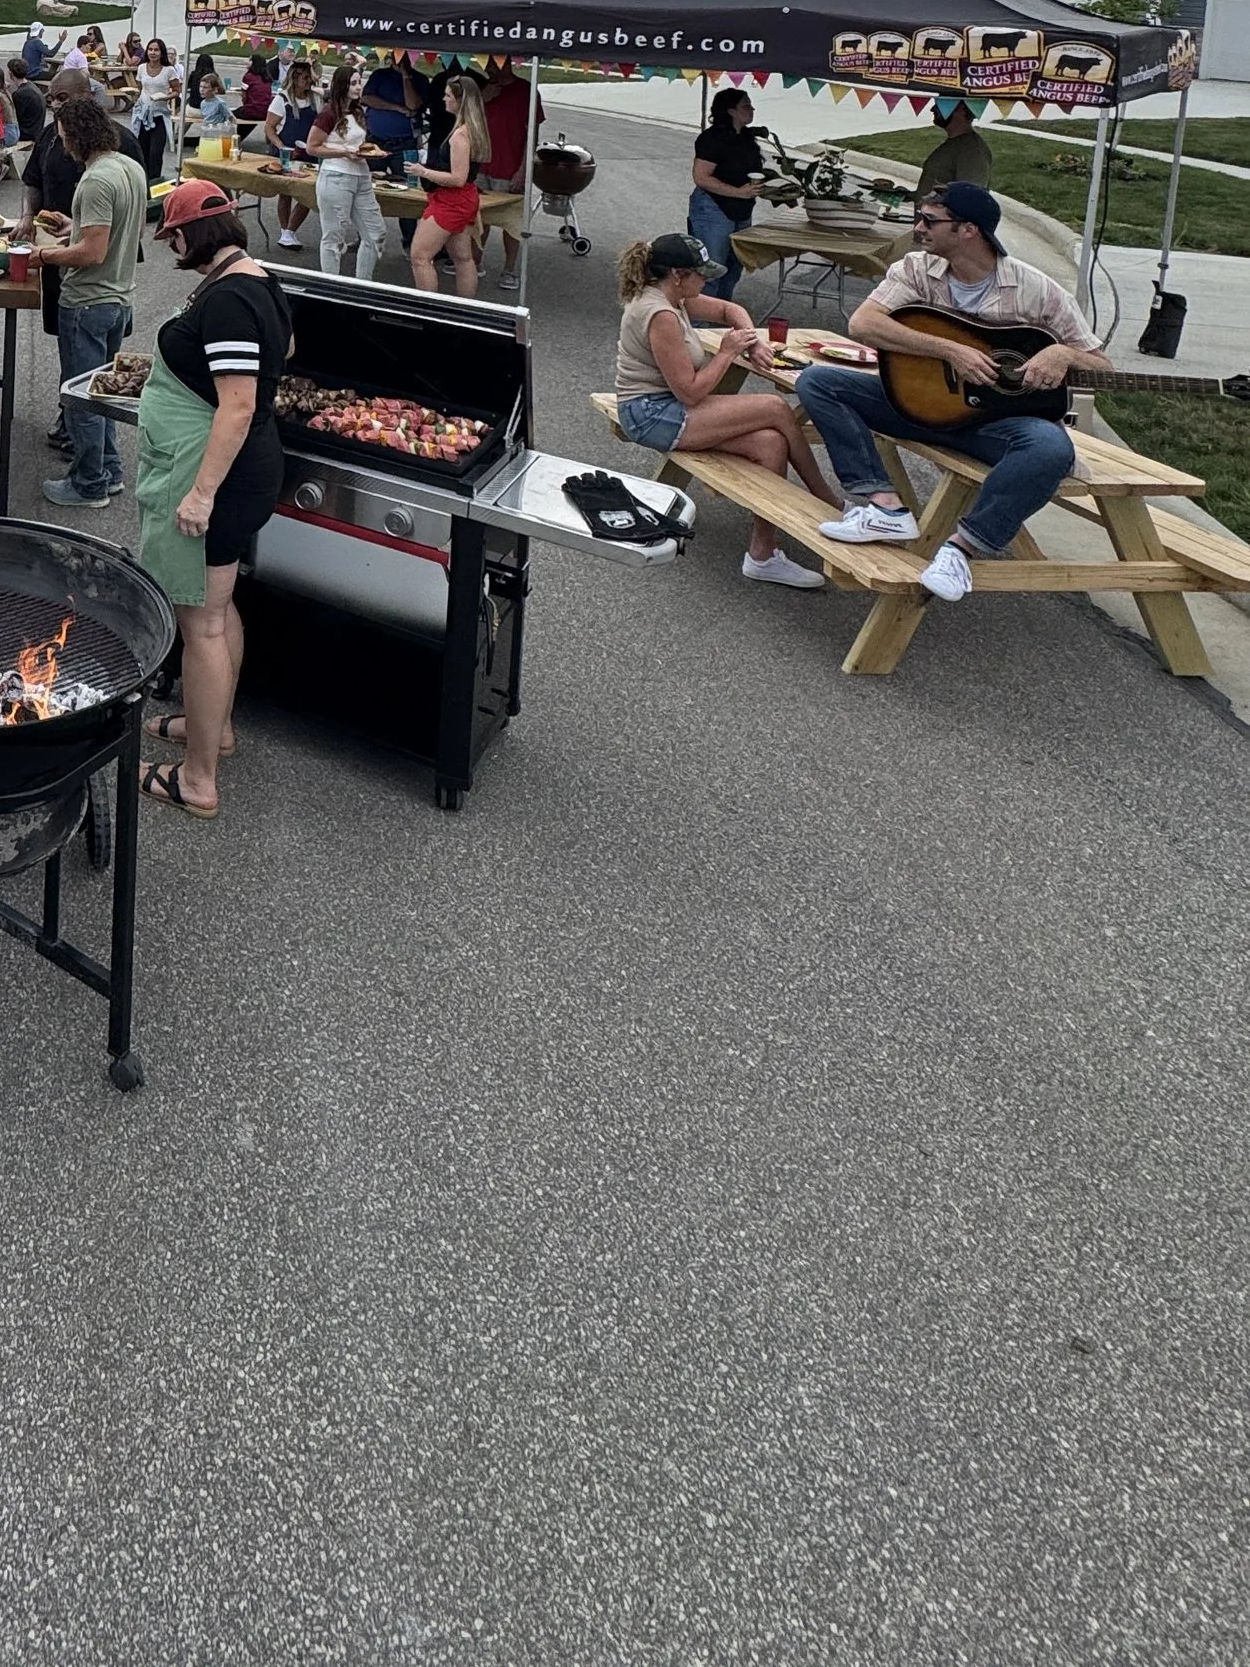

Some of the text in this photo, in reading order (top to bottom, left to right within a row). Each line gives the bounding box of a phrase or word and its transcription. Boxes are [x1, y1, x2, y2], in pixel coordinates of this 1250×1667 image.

[344, 16, 765, 54] www.certifiedangusbeef.com
[875, 59, 908, 67] RTIFIED
[967, 60, 1040, 77] CERTIFIED
[962, 73, 1031, 87] ANGUS BE
[1036, 79, 1105, 94] CERTIFIED
[1028, 88, 1073, 102] ANGUS
